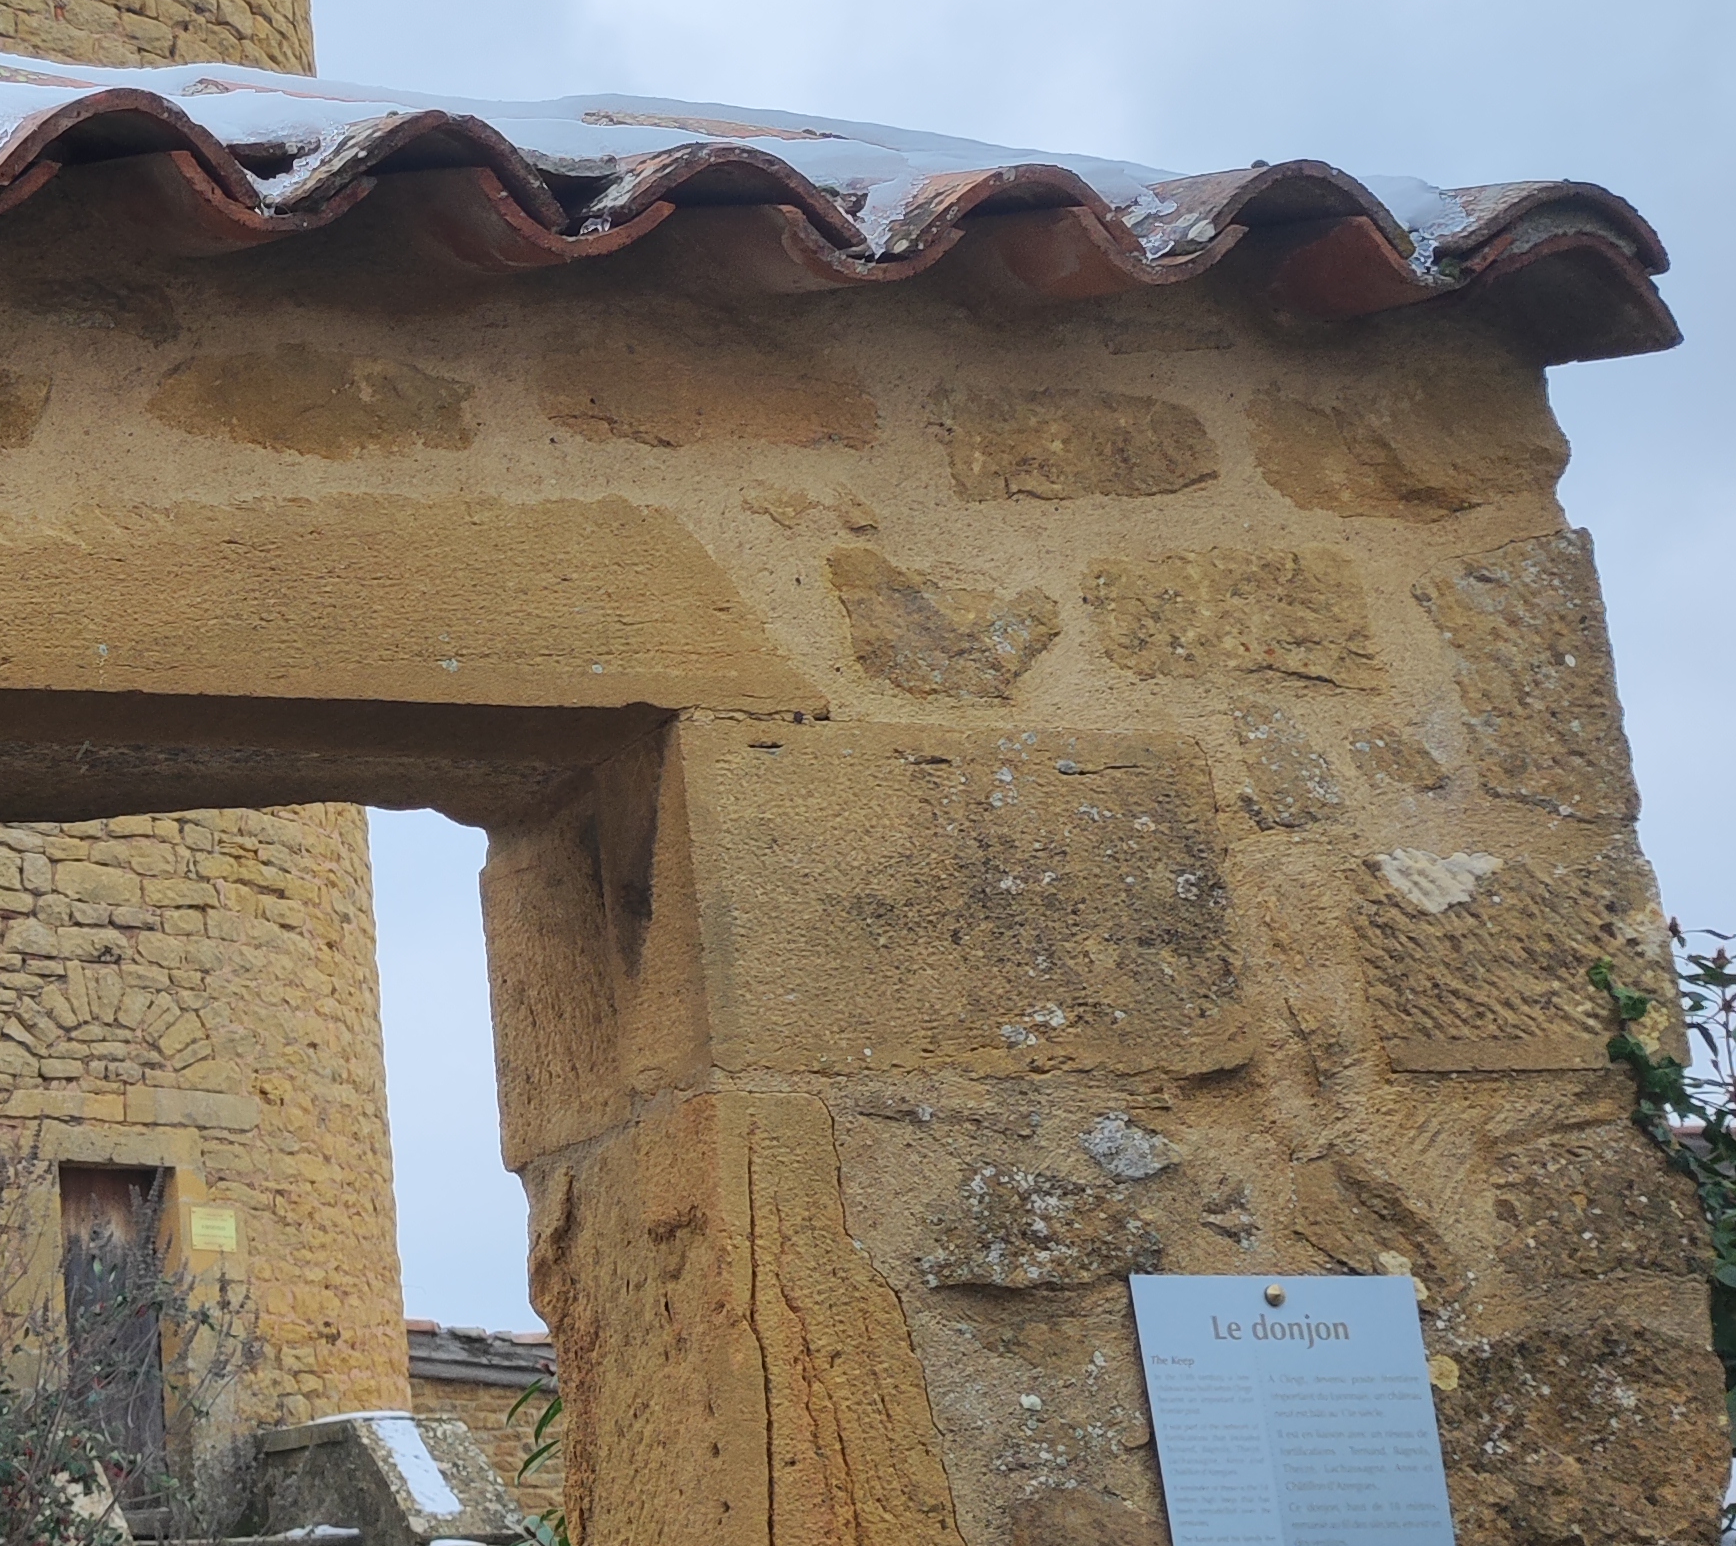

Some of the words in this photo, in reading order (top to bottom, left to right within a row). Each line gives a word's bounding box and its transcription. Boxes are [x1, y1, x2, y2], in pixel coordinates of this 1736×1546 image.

[1210, 1314, 1242, 1341] Le
[1251, 1312, 1350, 1350] donjon
[1150, 1355, 1169, 1366] The
[1171, 1355, 1195, 1369] Keep
